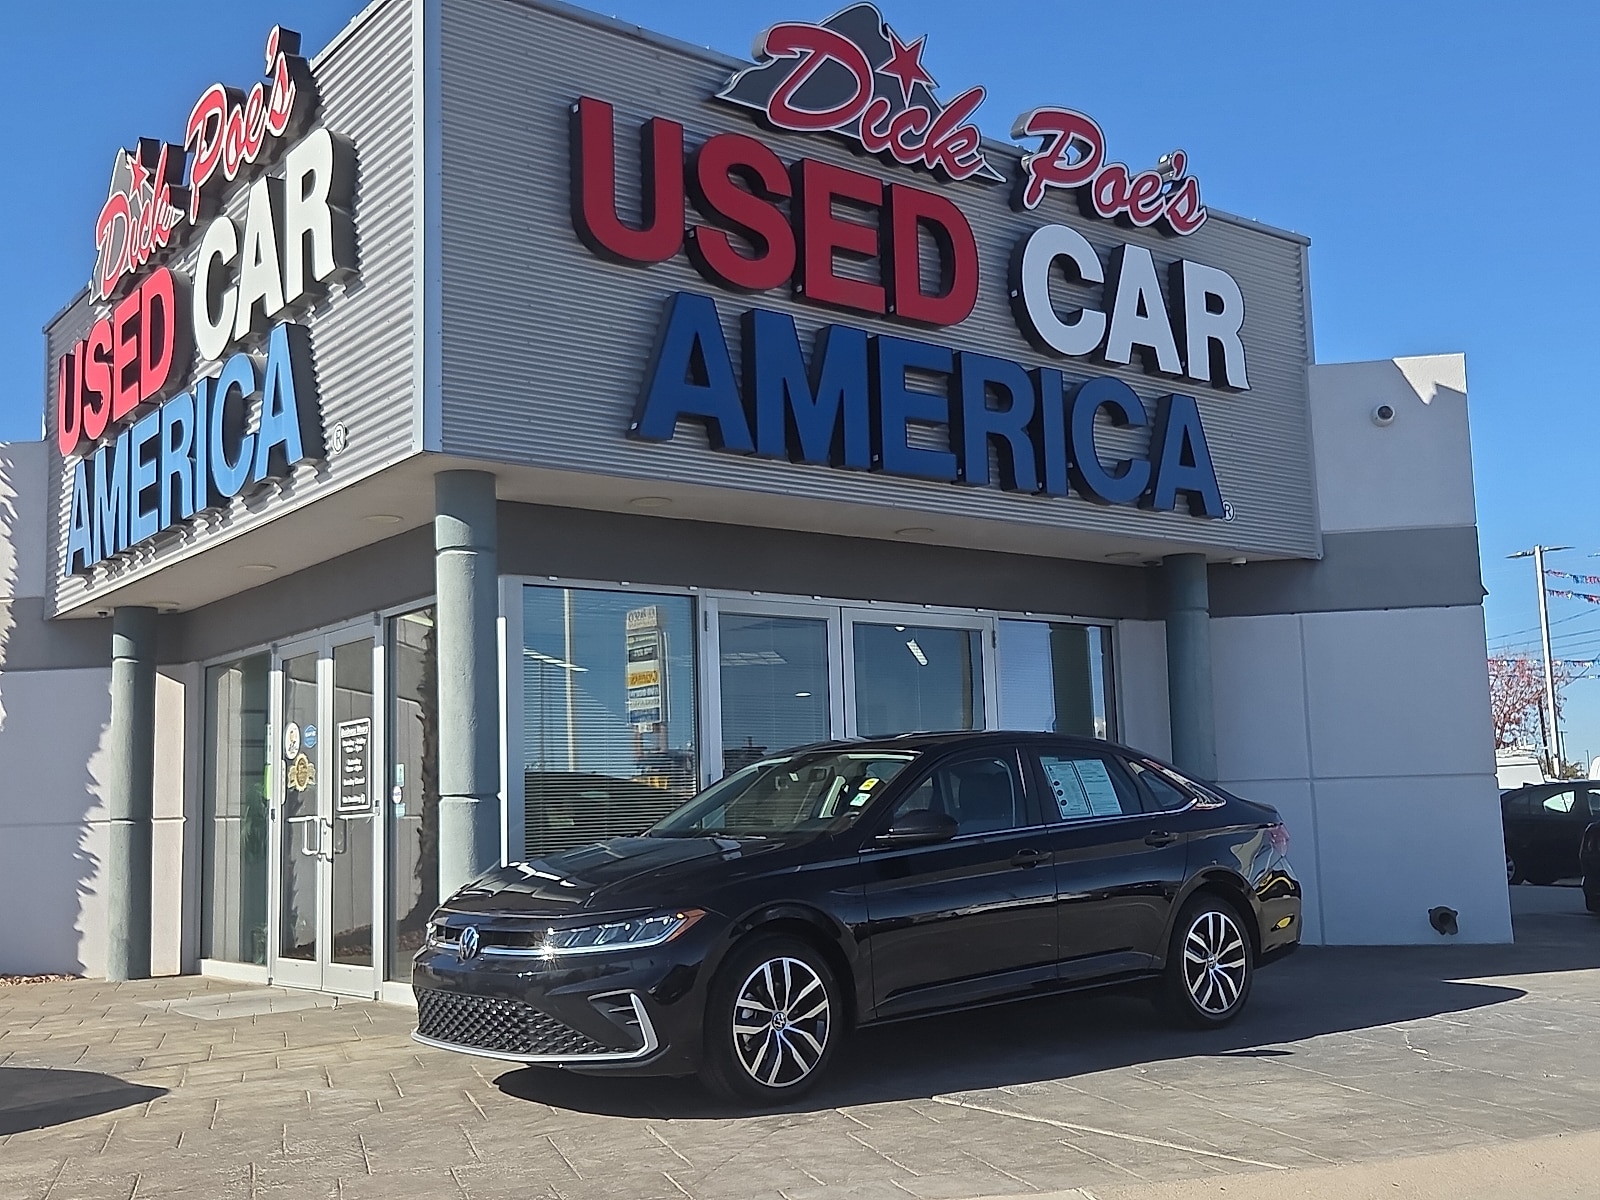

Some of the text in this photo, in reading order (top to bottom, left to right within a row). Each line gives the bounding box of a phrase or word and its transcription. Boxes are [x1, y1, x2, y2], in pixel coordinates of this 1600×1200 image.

[95, 23, 296, 300] Dick Poe's
[571, 97, 1251, 391] USED CAR
[764, 21, 1209, 236] Dick Poe's
[58, 128, 336, 457] USED CAR
[630, 291, 1224, 519] AMERICA
[65, 323, 304, 576] AMERICA
